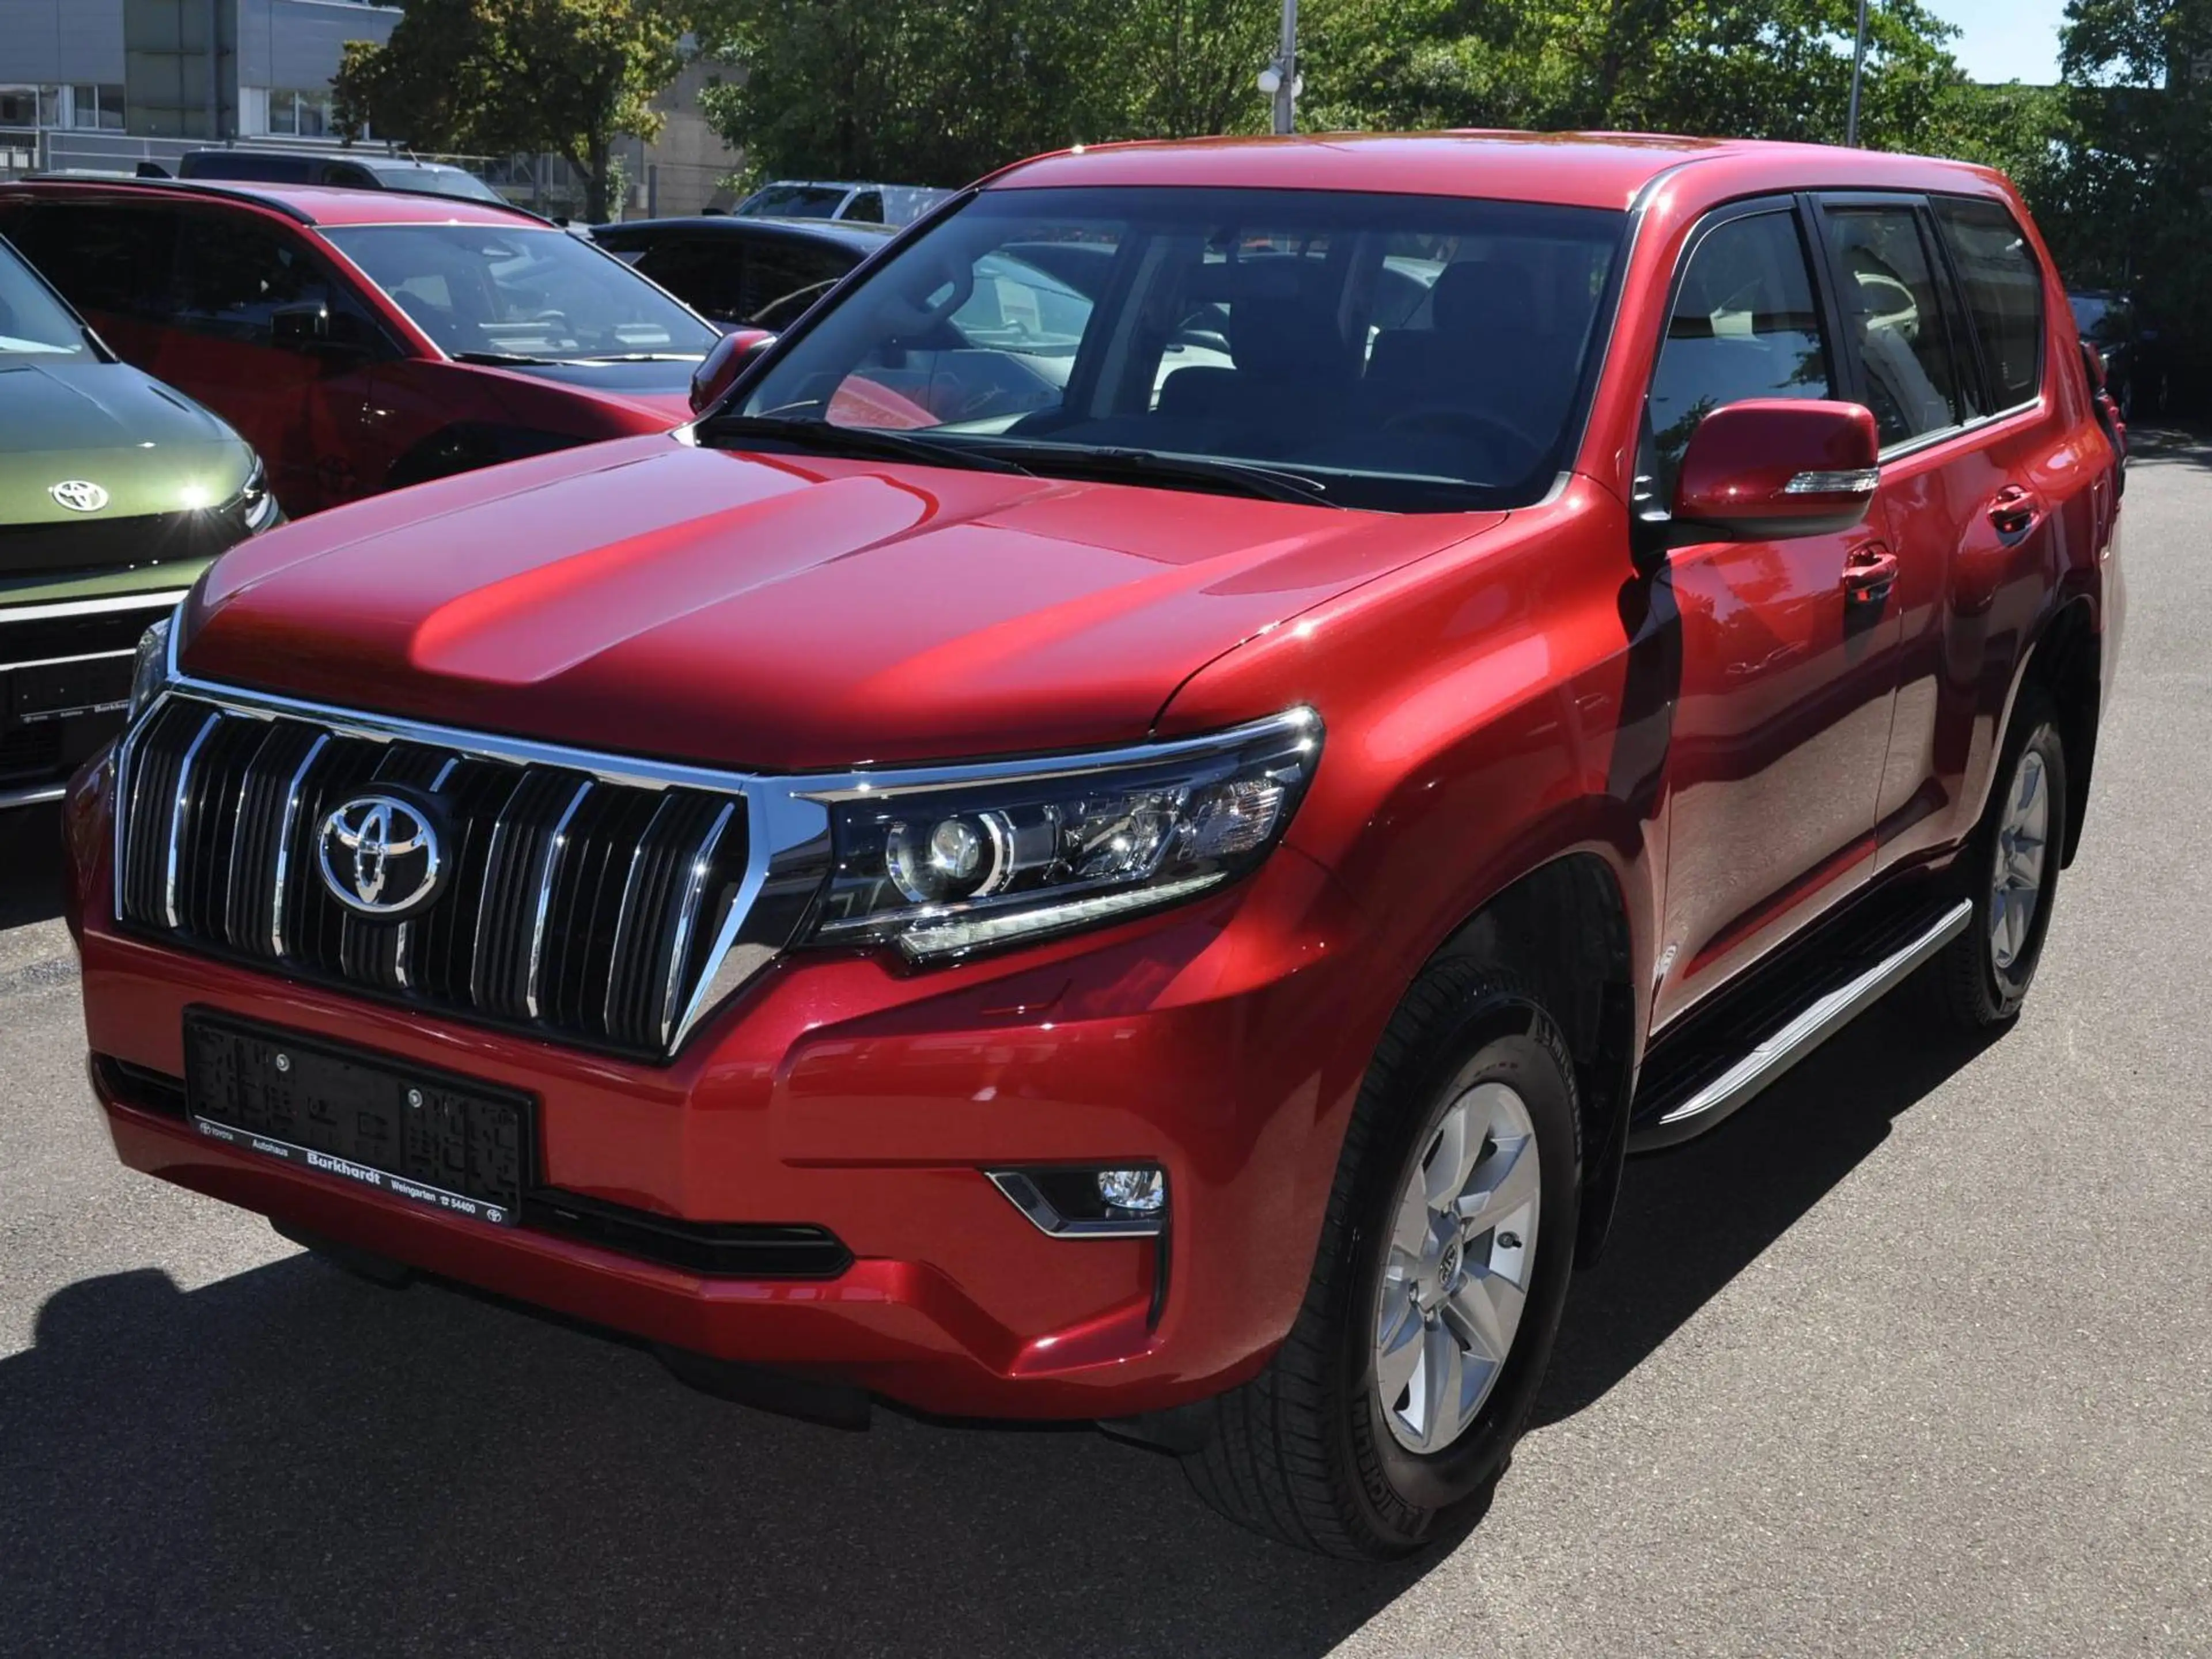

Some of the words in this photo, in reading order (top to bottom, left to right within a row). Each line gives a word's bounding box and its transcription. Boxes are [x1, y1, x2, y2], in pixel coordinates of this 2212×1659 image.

[252, 1138, 288, 1156] Autohaus
[307, 1152, 381, 1185] Burkhardt
[391, 1179, 435, 1201] Weingarten
[451, 1198, 475, 1214] 54400
